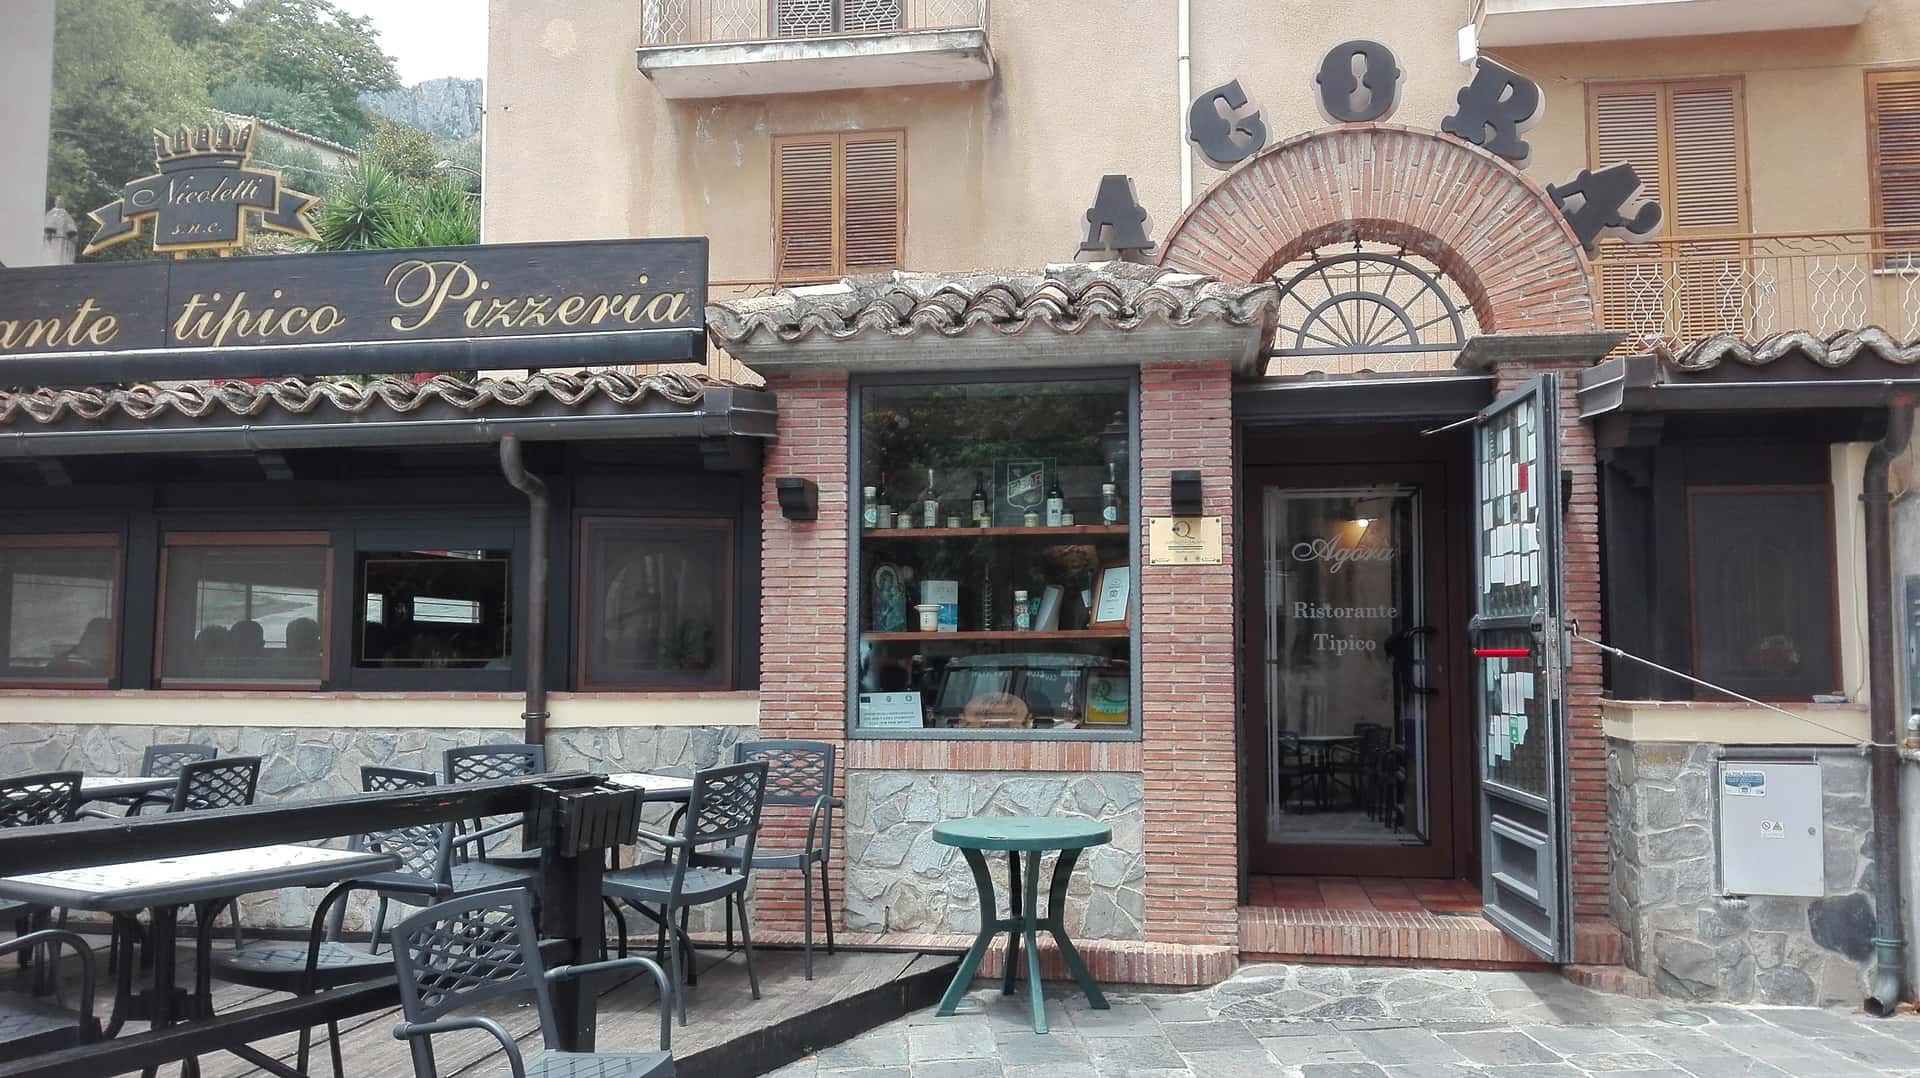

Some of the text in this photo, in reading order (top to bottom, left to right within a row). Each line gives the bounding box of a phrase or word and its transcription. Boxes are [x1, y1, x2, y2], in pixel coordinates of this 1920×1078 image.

[131, 175, 263, 208] Nicoletti
[171, 221, 223, 235] s.n.c.
[173, 289, 346, 348] tipico
[384, 259, 691, 331] Pizzeria
[1293, 601, 1398, 618] Ristorante
[1313, 633, 1376, 656] Tipico
